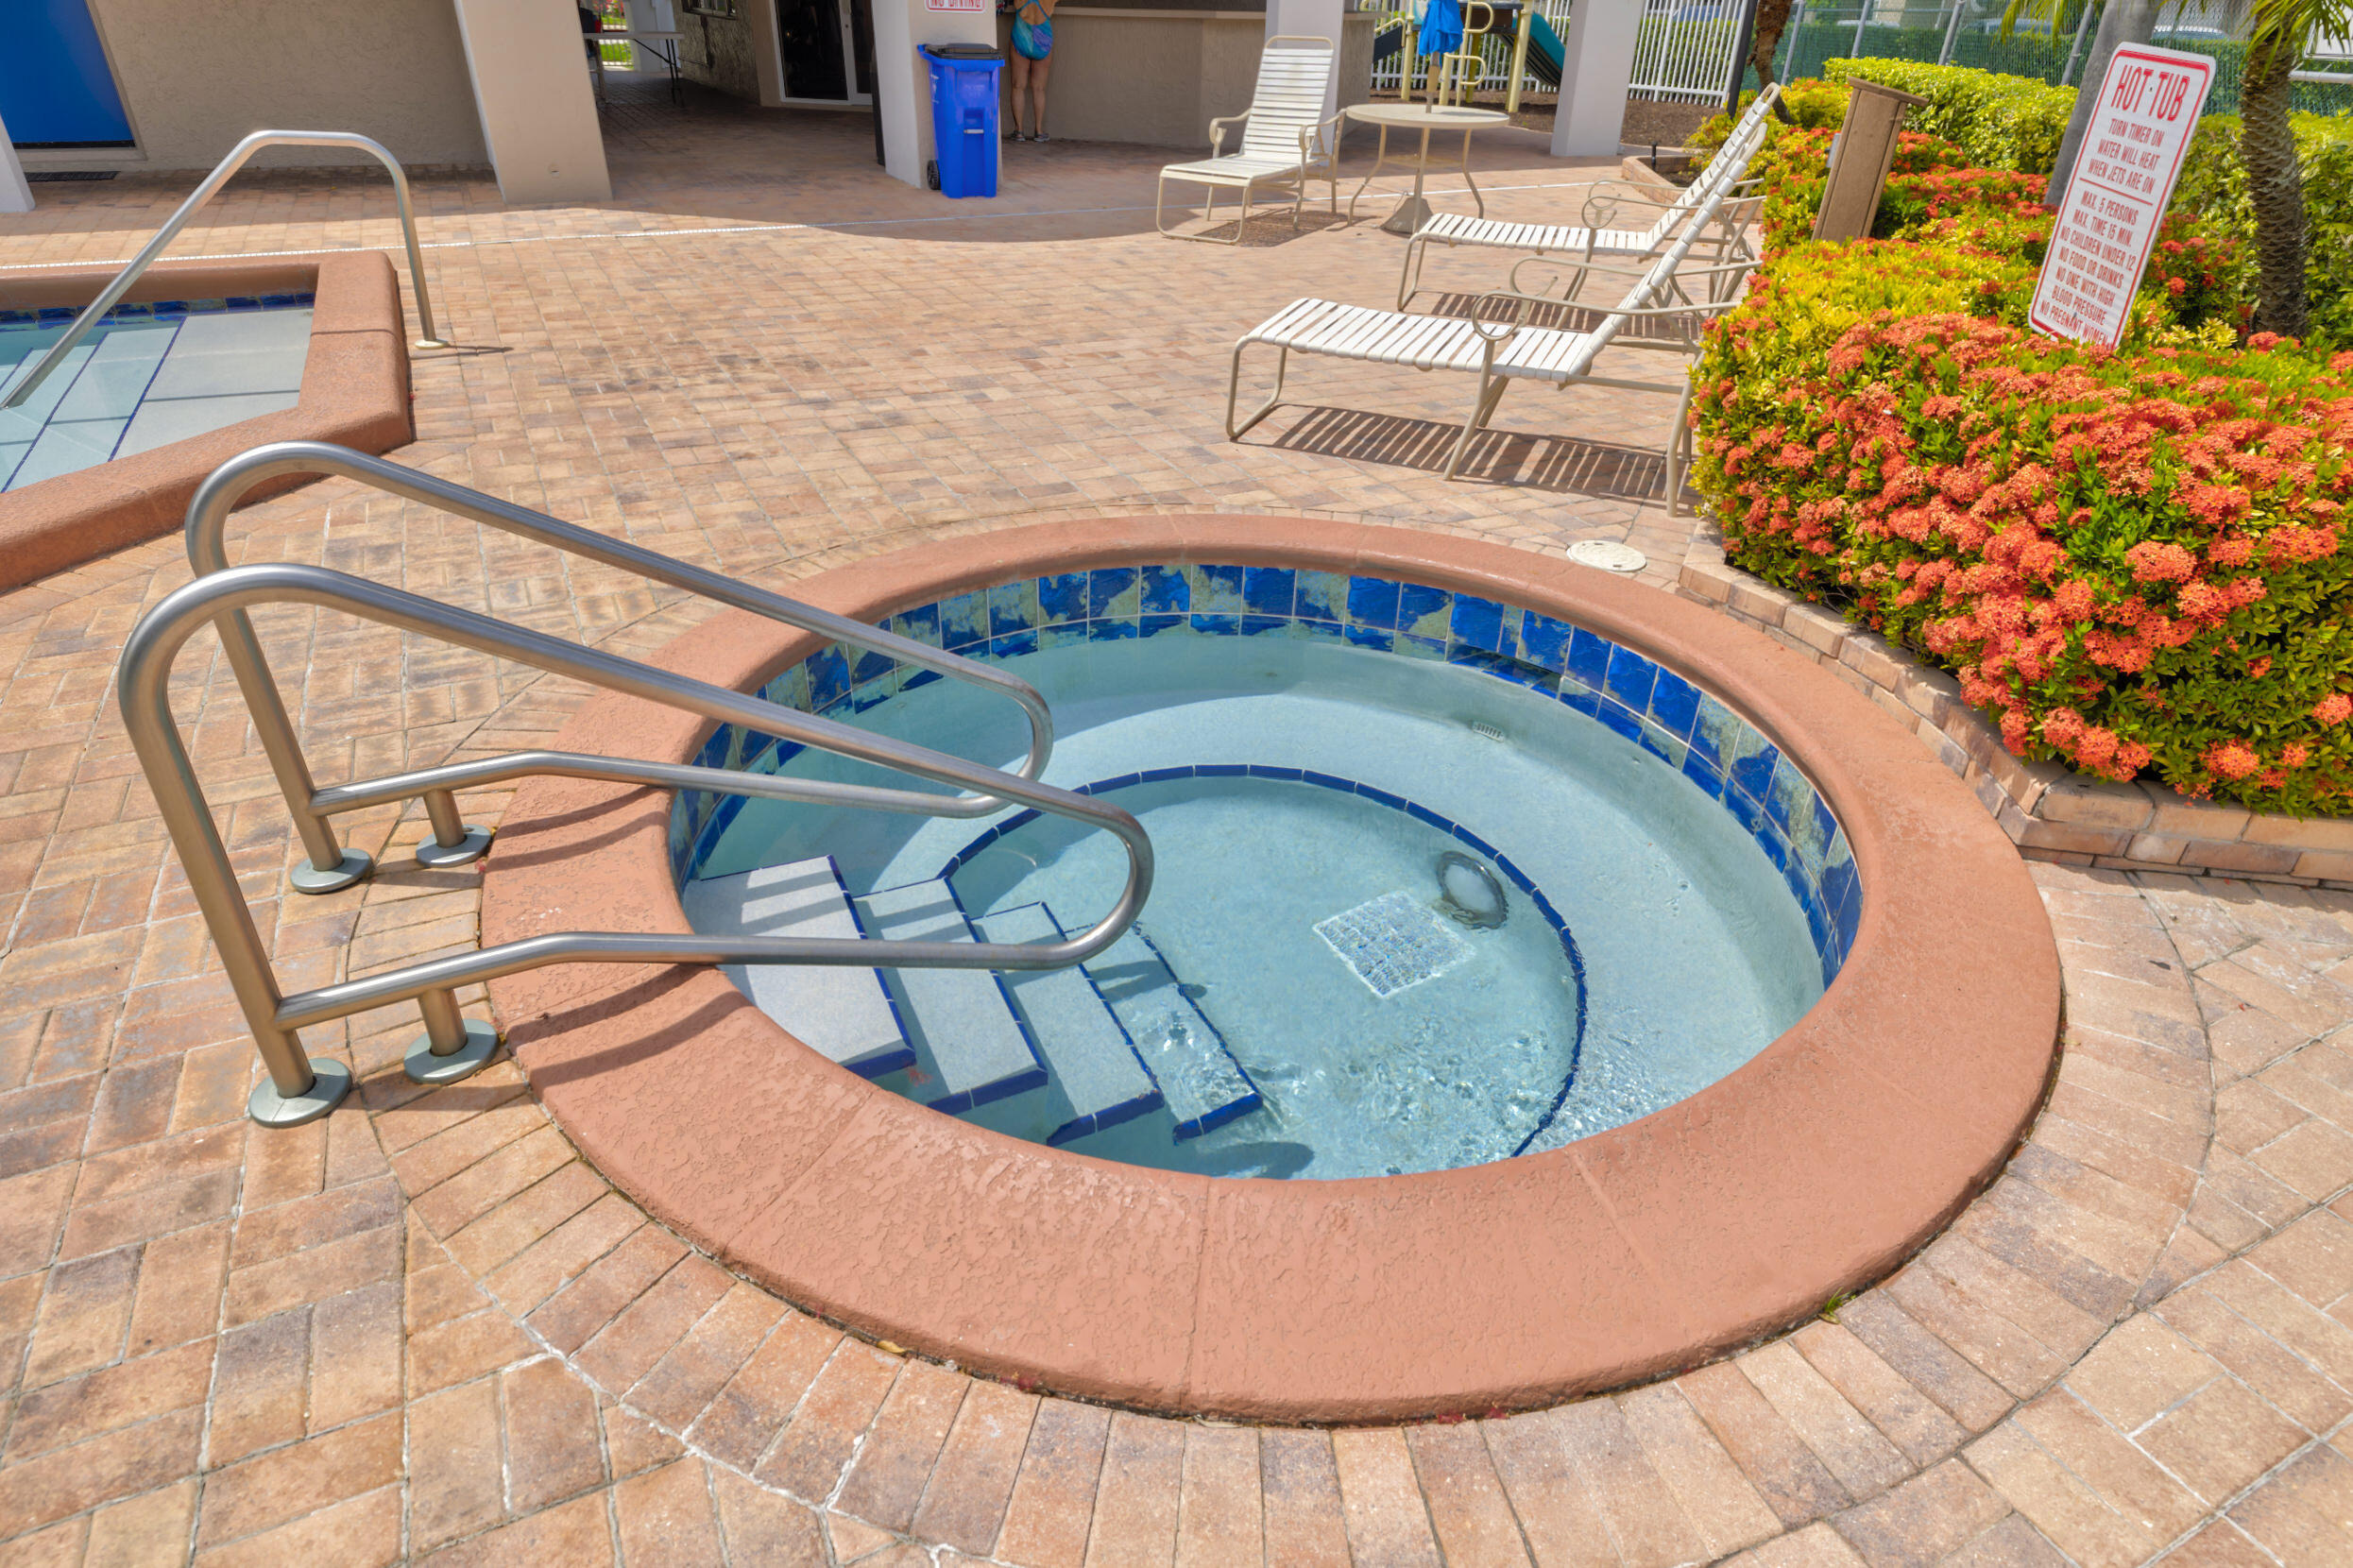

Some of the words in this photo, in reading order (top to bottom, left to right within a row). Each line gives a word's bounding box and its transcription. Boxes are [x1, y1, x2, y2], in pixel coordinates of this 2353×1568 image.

[2110, 64, 2154, 112] HOT
[2148, 71, 2190, 121] TUB
[2108, 118, 2128, 137] TURN
[2127, 123, 2152, 144] TIMER
[2151, 129, 2165, 147] ON
[2097, 138, 2122, 159] WATER
[2121, 145, 2139, 164] WILL
[2139, 151, 2160, 171] HEAT
[2088, 158, 2108, 179] WHEN
[2107, 165, 2126, 184] JETS
[2125, 171, 2142, 190] ARE
[2141, 176, 2156, 195] ON
[2081, 190, 2097, 210] MAX.
[2098, 197, 2106, 213] 5
[2105, 199, 2139, 226] PERSONS
[2059, 225, 2071, 241] NO
[2070, 230, 2103, 256] CHILDREN
[2101, 244, 2125, 266] UNDER
[2125, 254, 2136, 271] 12
[2090, 215, 2108, 236] TIME
[2107, 223, 2117, 240] 15
[2116, 227, 2134, 247] MIN.
[2055, 265, 2066, 281] NO
[2066, 271, 2080, 289] ONE
[2080, 278, 2098, 298] WITH
[2097, 286, 2116, 307] HIGH
[2058, 246, 2069, 263] NO
[2069, 250, 2087, 270] FOOD
[2087, 259, 2097, 276] OR
[2097, 264, 2124, 289] DRINKS
[2040, 299, 2050, 315] NO
[2049, 305, 2083, 333] PREGNANT
[2083, 323, 2109, 345] WOMEN
[2052, 284, 2073, 307] BLOOD
[2072, 296, 2107, 326] PRESSURE
